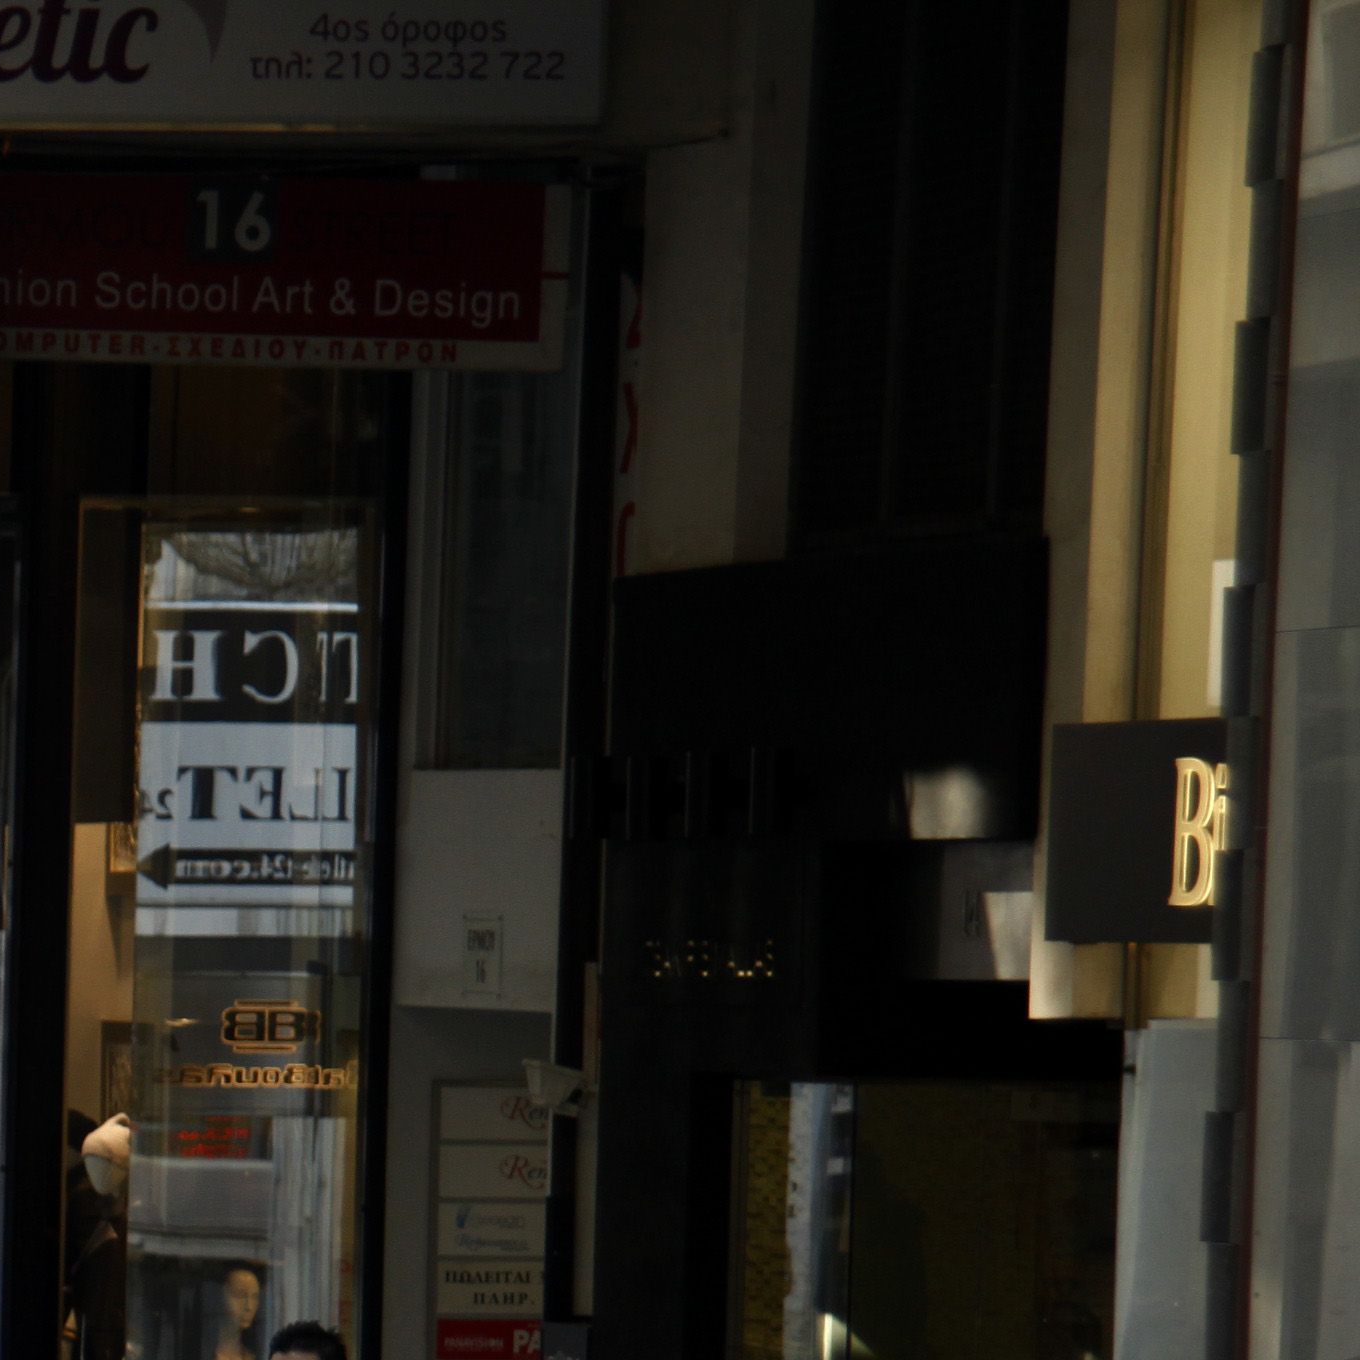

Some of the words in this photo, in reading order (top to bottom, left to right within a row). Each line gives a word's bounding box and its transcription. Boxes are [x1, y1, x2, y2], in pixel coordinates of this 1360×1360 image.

[324, 50, 391, 80] 210
[400, 50, 489, 80] 3232
[499, 51, 566, 80] 722
[193, 189, 274, 254] 16
[94, 271, 240, 312] School
[252, 276, 314, 319] Art
[373, 281, 520, 330] Design
